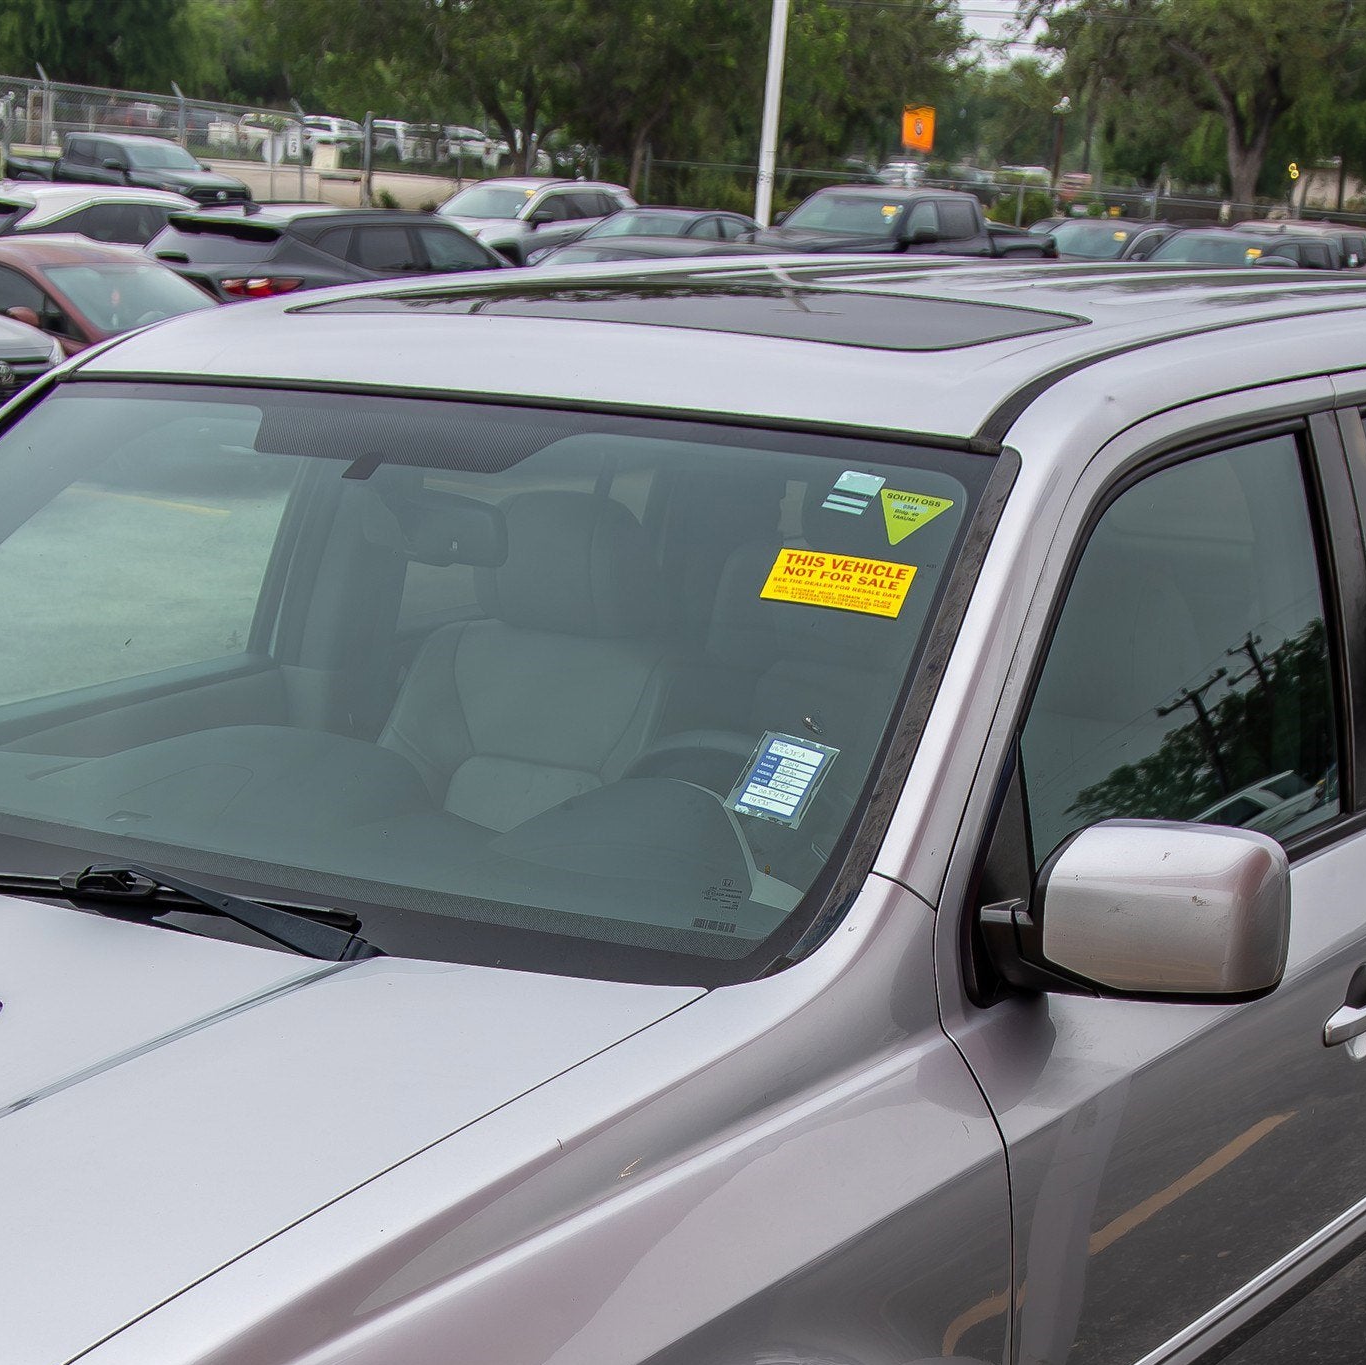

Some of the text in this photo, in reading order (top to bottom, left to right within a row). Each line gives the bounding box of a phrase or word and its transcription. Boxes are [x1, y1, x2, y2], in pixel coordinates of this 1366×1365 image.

[886, 492, 942, 508] SOUTH OSS
[786, 553, 826, 568] THIS
[831, 558, 910, 581] VEHICLE
[783, 566, 900, 591] NOT FOR SALE
[804, 580, 834, 589] DEALER
[835, 583, 850, 591] FOR
[852, 586, 881, 595] RESALE
[882, 592, 902, 600] DATE
[752, 776, 769, 784] COLOR
